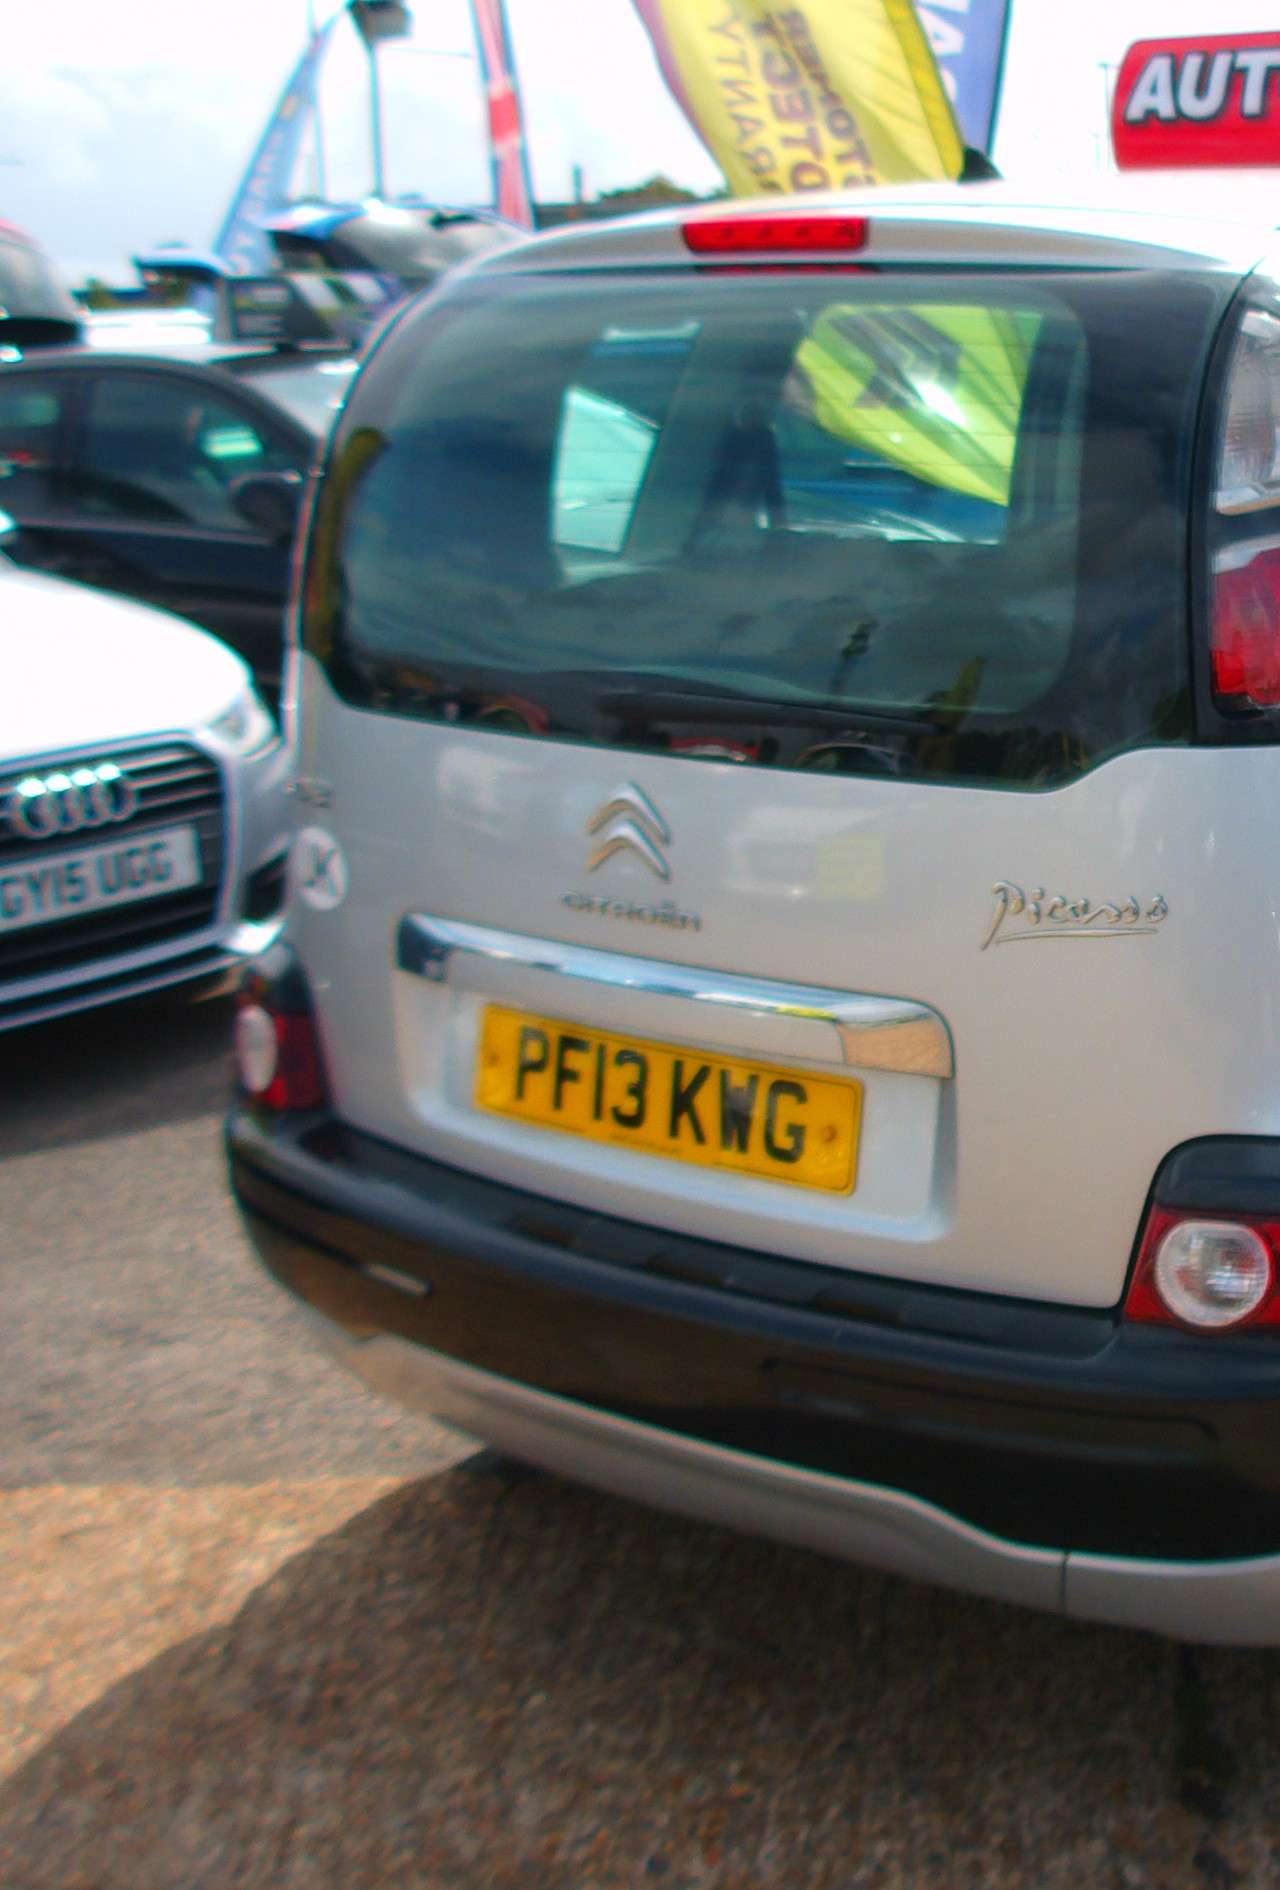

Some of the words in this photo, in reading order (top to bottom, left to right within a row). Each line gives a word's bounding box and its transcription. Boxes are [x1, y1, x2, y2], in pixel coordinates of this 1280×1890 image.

[0, 860, 88, 919] GY15
[96, 841, 172, 896] UGG
[980, 880, 1168, 951] Picasso
[513, 1024, 648, 1130] PF13
[667, 1058, 809, 1164] KWG
